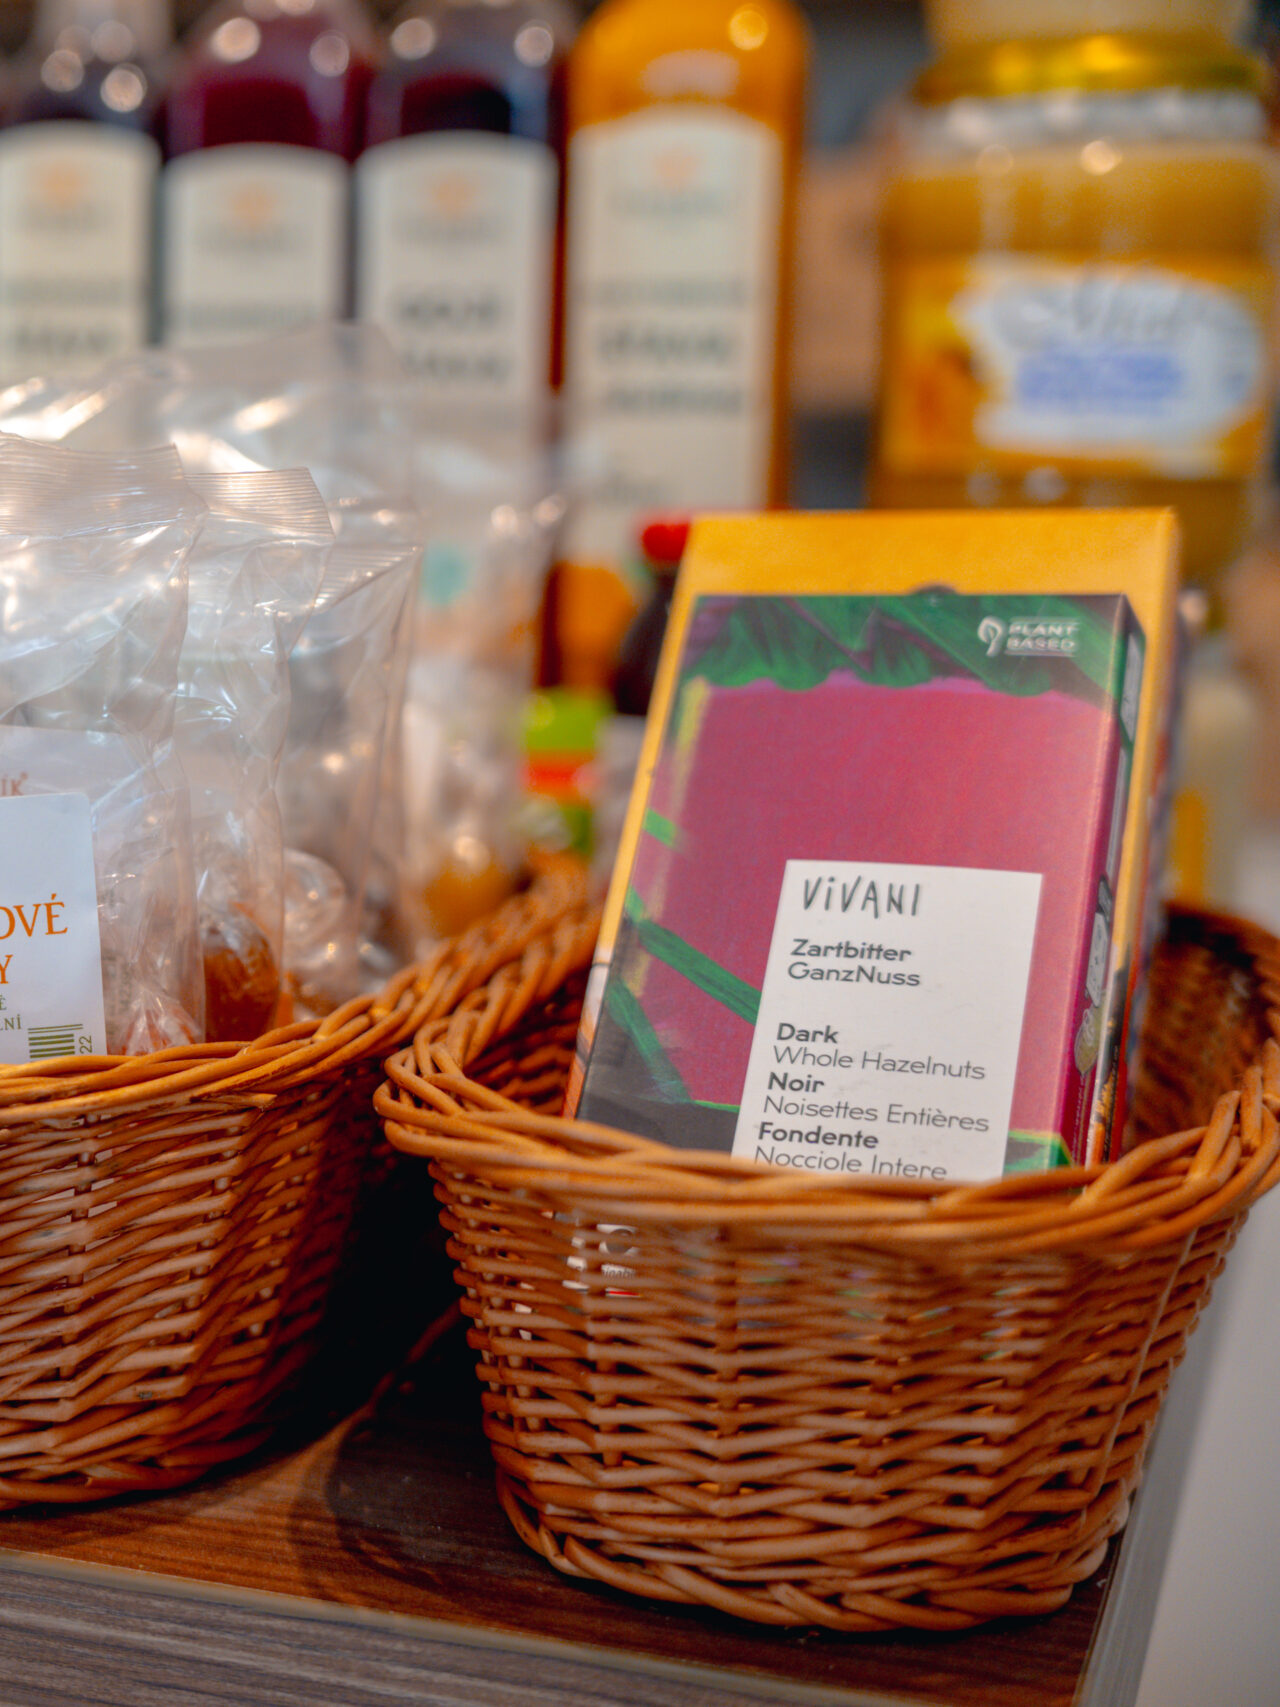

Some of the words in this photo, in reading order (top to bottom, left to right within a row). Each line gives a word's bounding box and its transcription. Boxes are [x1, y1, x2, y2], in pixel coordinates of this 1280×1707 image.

[1008, 624, 1078, 636] PLANT
[1006, 637, 1076, 649] BASED
[790, 938, 912, 963] Zartbitter
[787, 961, 922, 987] GanzNuss
[776, 1022, 839, 1045] Dark
[773, 1045, 854, 1070] Whole
[861, 1050, 986, 1081] Hazelnuts
[767, 1072, 825, 1094] Noir
[763, 1095, 879, 1123] Noisettes
[886, 1103, 990, 1133] Entières
[757, 1121, 879, 1149] Fondente
[754, 1146, 863, 1174] Nocciole
[871, 1155, 948, 1182] Intere
